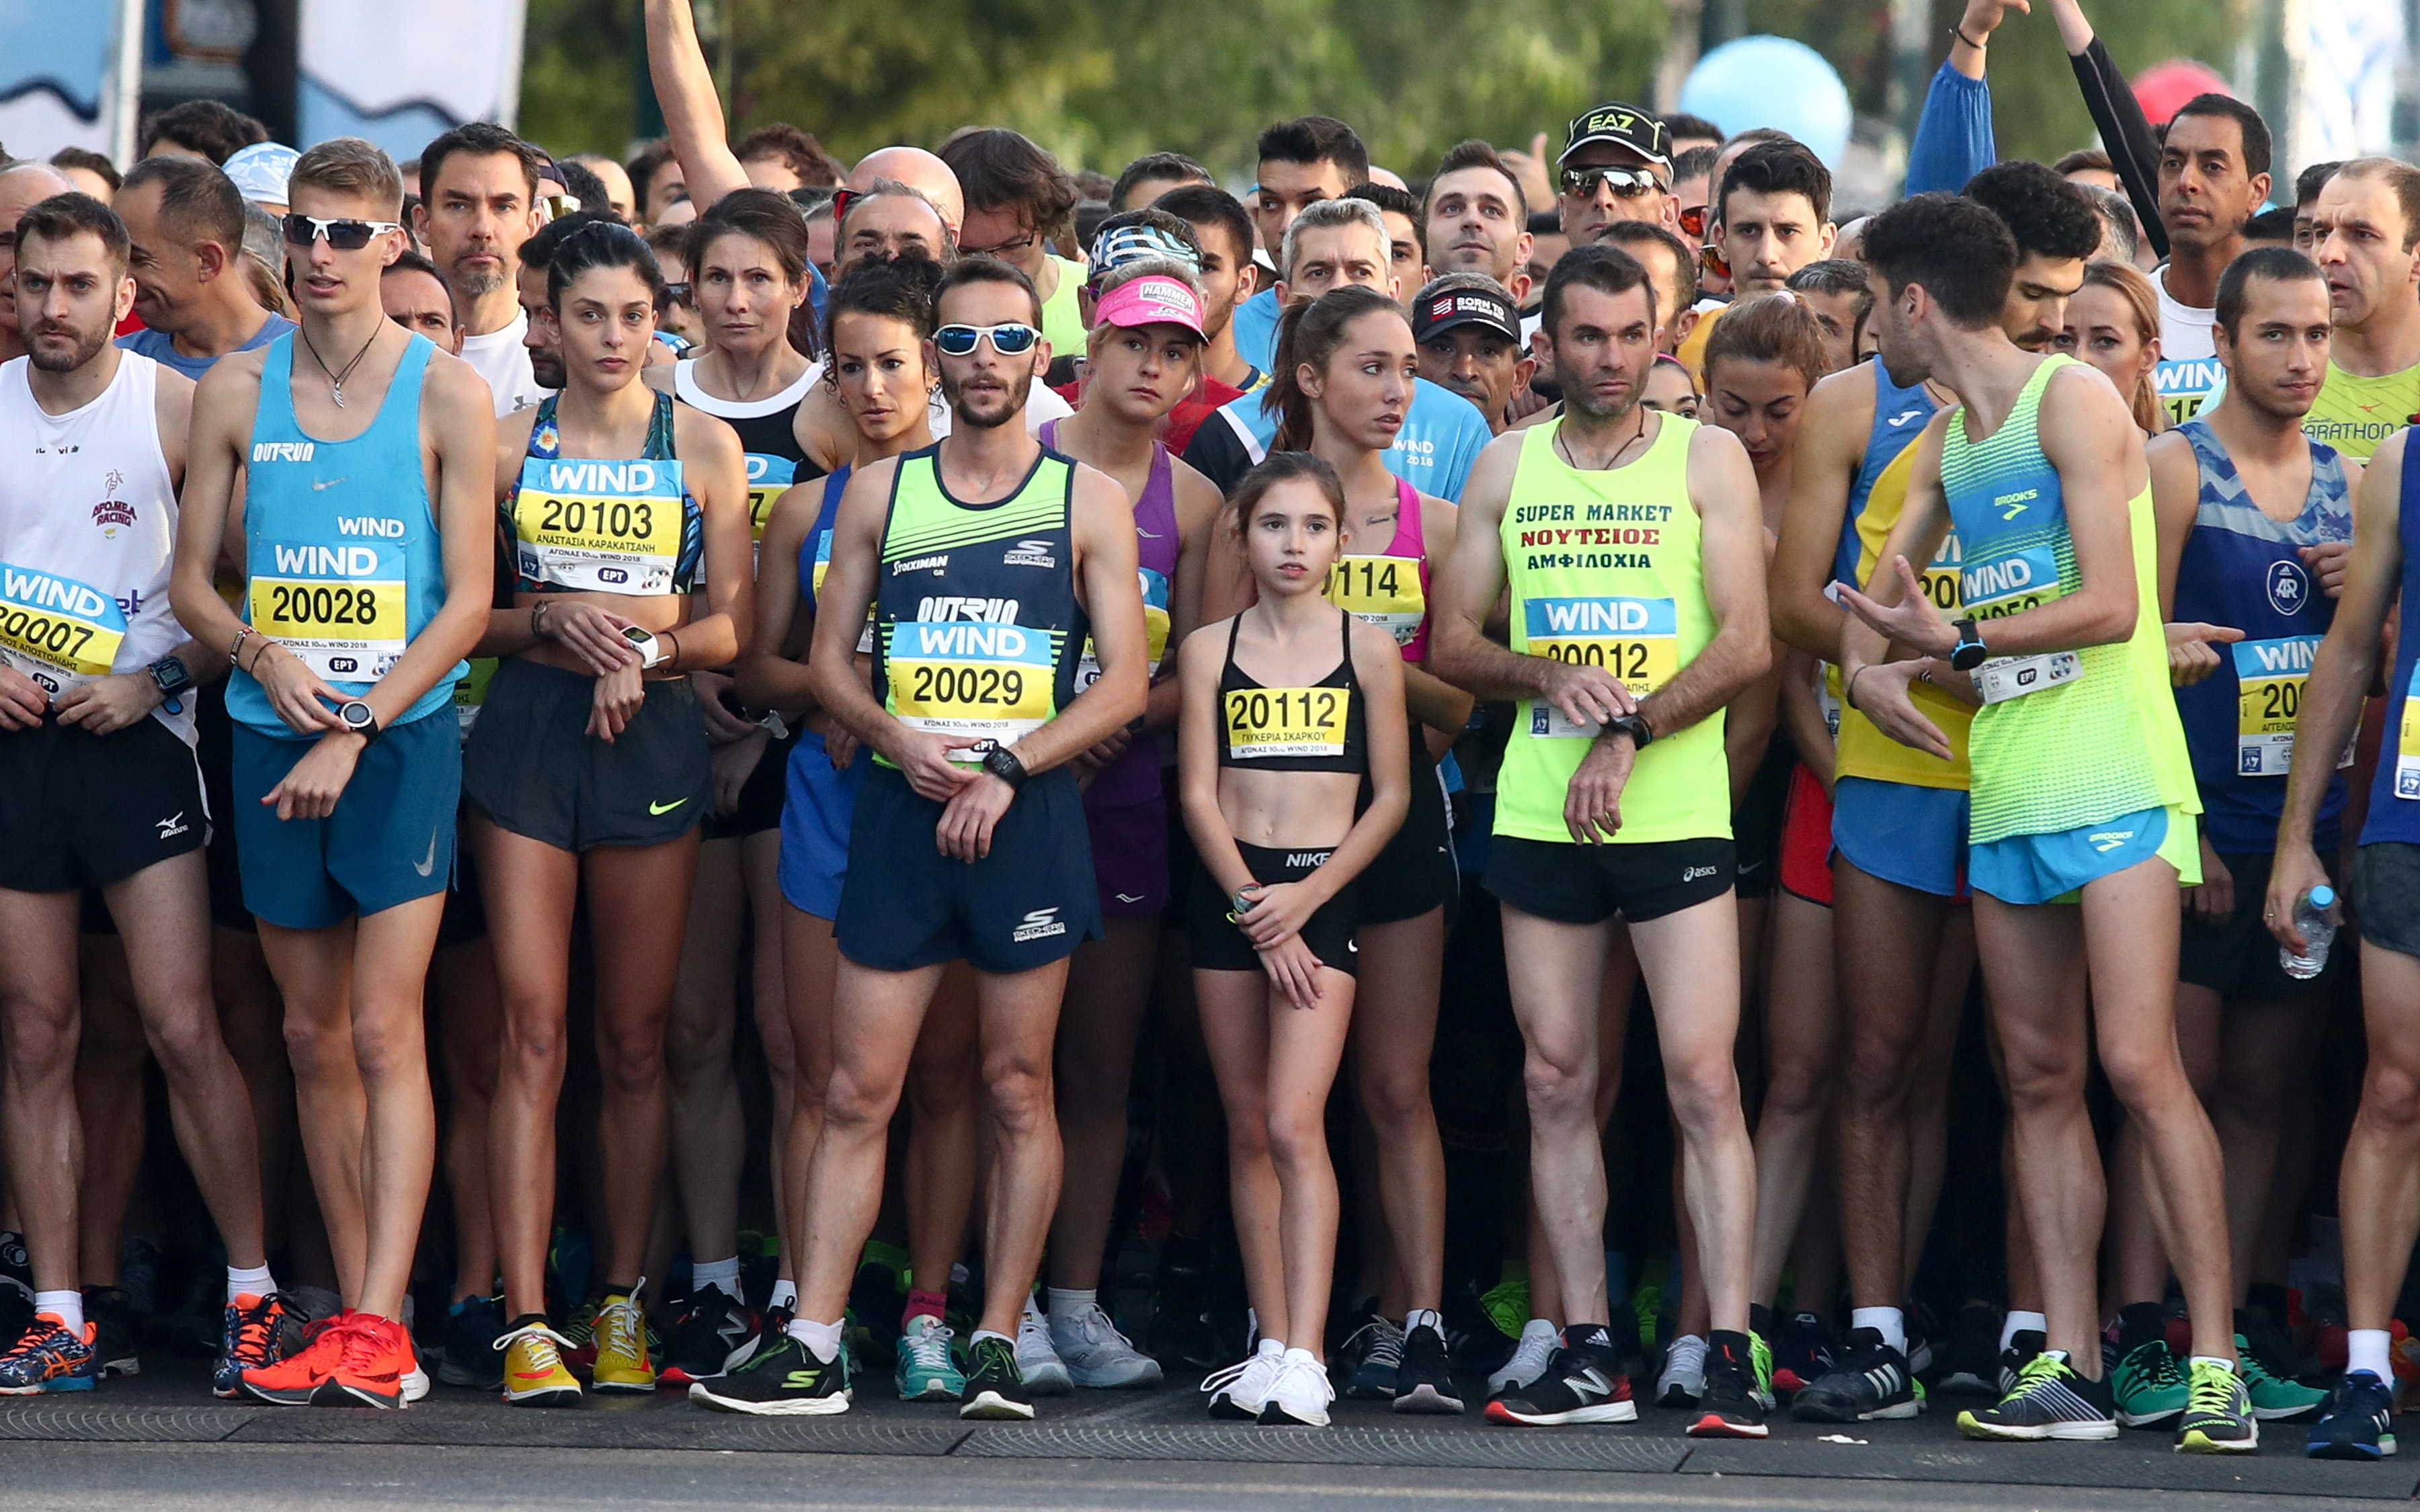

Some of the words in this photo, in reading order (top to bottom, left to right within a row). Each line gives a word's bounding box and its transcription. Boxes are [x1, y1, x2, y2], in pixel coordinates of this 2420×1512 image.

[1588, 114, 1635, 128] EA7
[1144, 285, 1193, 308] HAMMER
[1457, 297, 1491, 309] BORN
[1492, 303, 1504, 317] TO
[2154, 362, 2222, 390] WIN
[2304, 423, 2394, 439] ARATHON
[253, 442, 314, 462] OUTRUN
[1393, 439, 1434, 454] WIND
[1406, 454, 1434, 467] 2018
[551, 464, 655, 492] WIND
[1994, 489, 2038, 507] BROOKS
[96, 512, 132, 527] RACING
[541, 499, 652, 539] 20103
[1516, 505, 1574, 523] SUPER
[1586, 505, 1672, 522] MARKET
[337, 516, 405, 538] WIND
[1521, 528, 1660, 548] ΝΟΥΤΣΙΟΣ
[536, 534, 585, 547] ΑΝΑΣΤΑΣΙΑ
[588, 538, 655, 552] ΚΑΡΑΚΑΤΣΑΝΗ
[275, 544, 378, 576] WIND
[1527, 554, 1652, 570] ΑΜΦΙΛΟΧΙΑ
[603, 571, 624, 581] ΕΡΤ
[1338, 561, 1398, 597] 114
[1962, 558, 2031, 599] WIND
[5, 569, 106, 617] WIND
[272, 586, 376, 624] 20028
[916, 597, 1019, 625] OUTRUN
[1545, 601, 1649, 632] WIND
[919, 626, 1026, 657] WIND
[19, 644, 79, 671] ΑΠΟΣΤΟΛΙΔΗΣ
[35, 660, 55, 671] WIND
[333, 660, 354, 671] ΕΡΤ
[2254, 640, 2320, 671] WIN
[914, 667, 1022, 706] 20029
[1231, 692, 1335, 730] 20112
[1242, 732, 1281, 743] ΓΛΥΚΕΡΙΑ
[1284, 732, 1326, 741] ΣΚΑΡΚΟΥ
